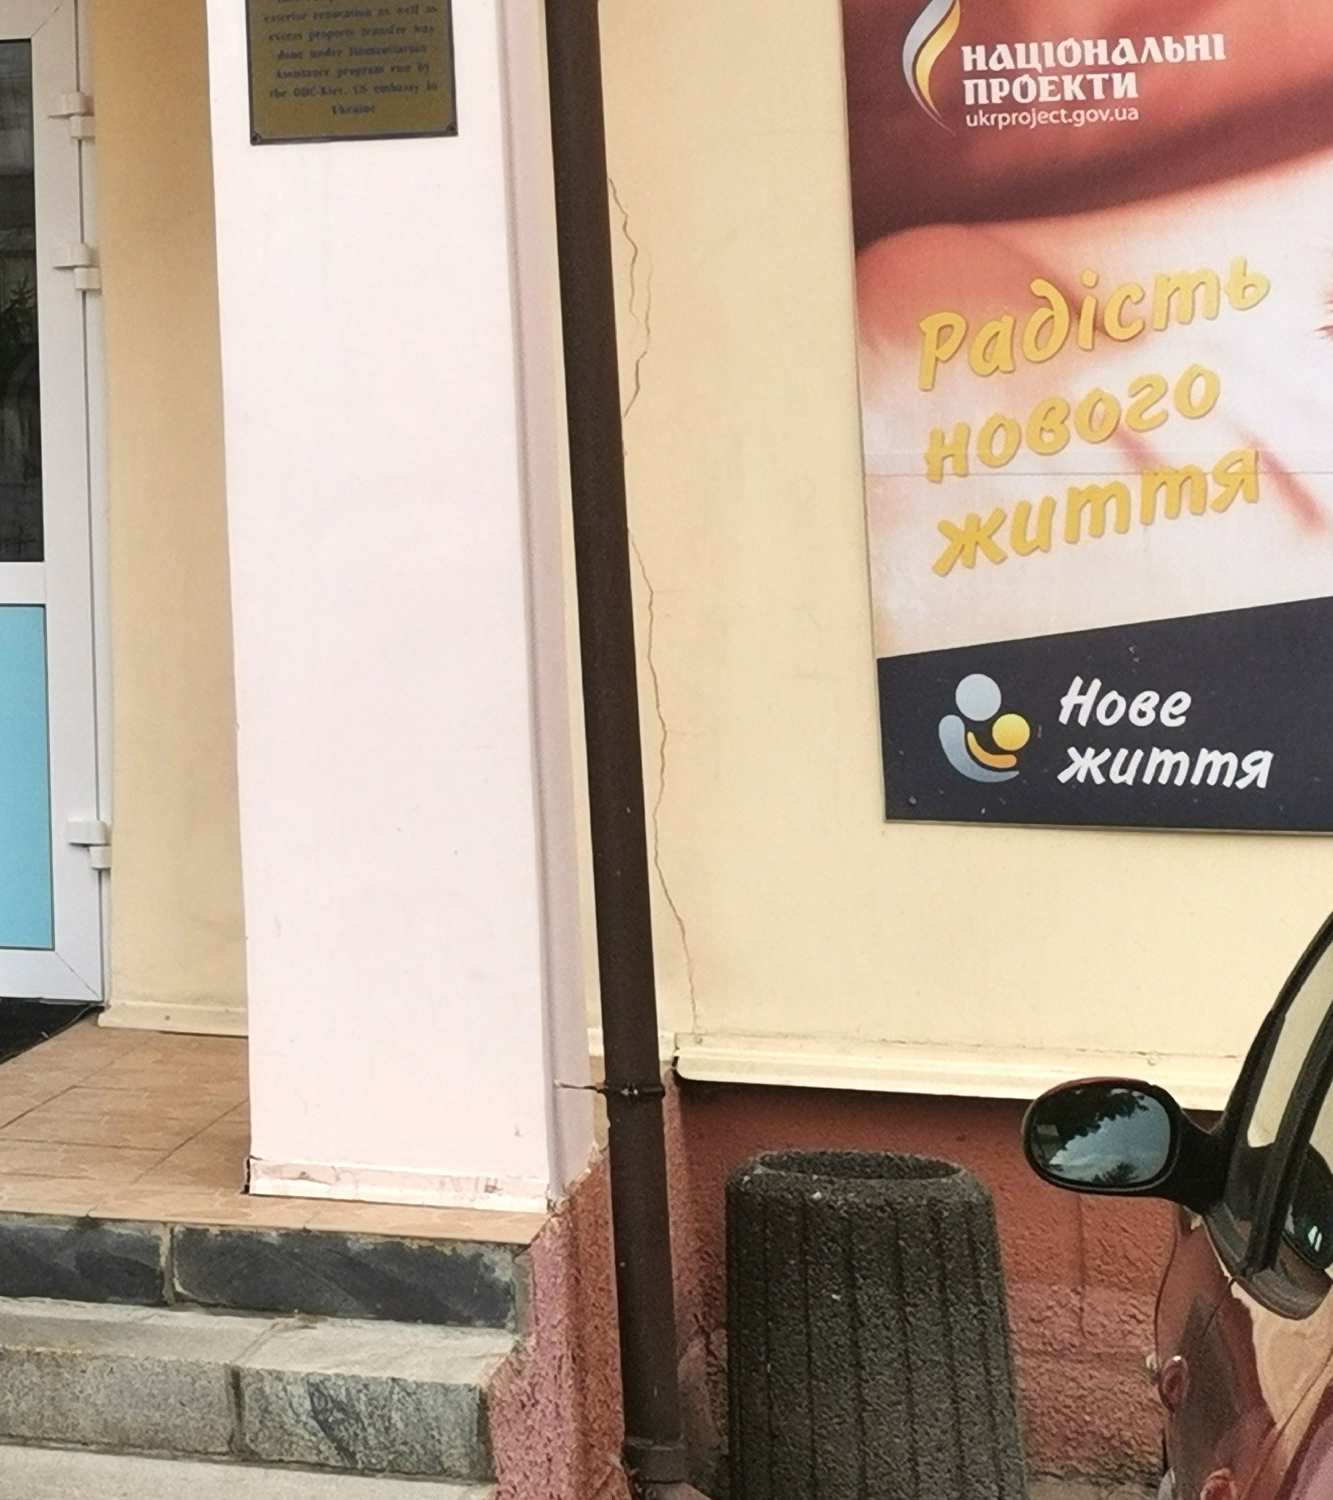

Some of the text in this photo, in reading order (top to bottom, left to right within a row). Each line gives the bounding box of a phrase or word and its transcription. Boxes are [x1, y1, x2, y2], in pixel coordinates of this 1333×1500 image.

[961, 32, 1227, 74] НАЦІОНАЛЬНІ
[962, 70, 1139, 106] ПРОЕКТИ
[965, 104, 1140, 131] ukrproject.gov.ua
[918, 256, 1271, 392] Радість
[924, 363, 1221, 484] нового
[932, 446, 1261, 578] життя
[1057, 676, 1192, 728] Нове
[1056, 745, 1275, 791] життя
